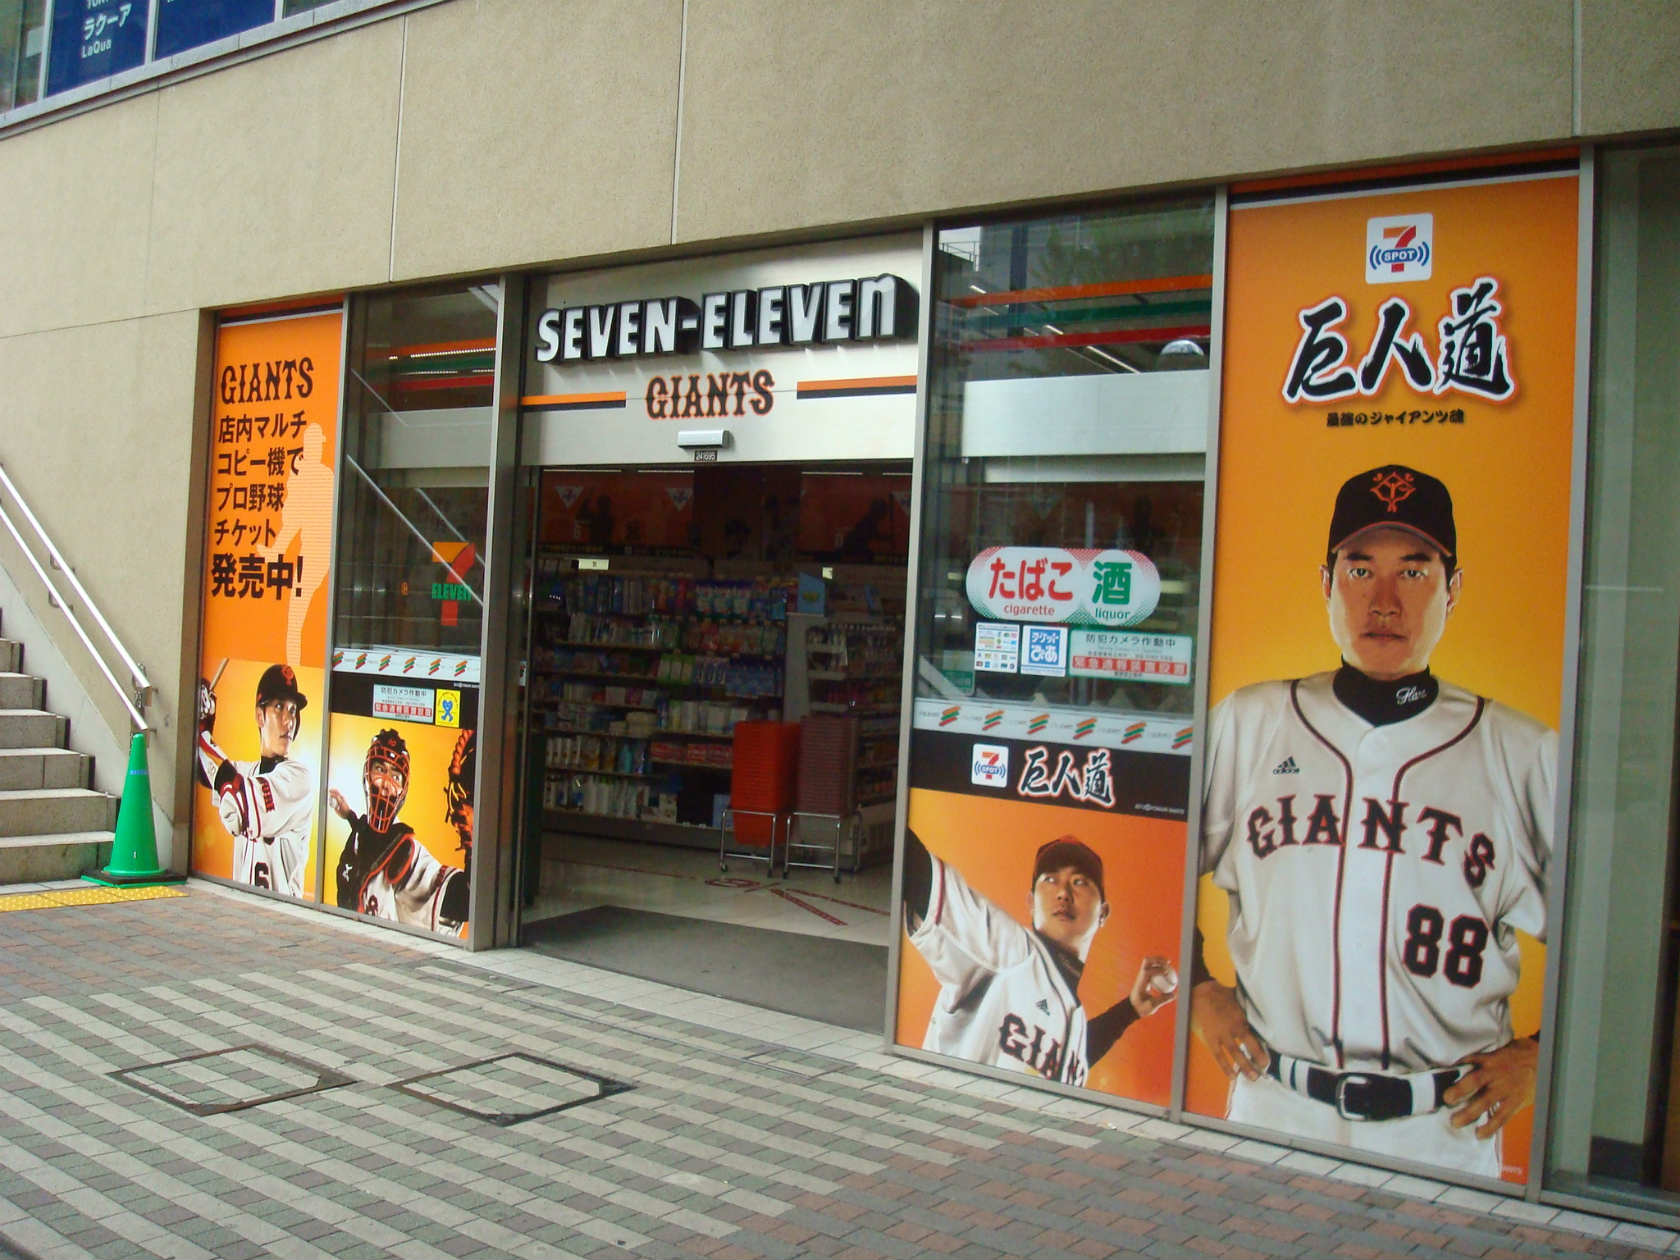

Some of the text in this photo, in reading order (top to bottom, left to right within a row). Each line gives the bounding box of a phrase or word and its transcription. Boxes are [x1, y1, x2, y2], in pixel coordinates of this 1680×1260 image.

[84, 3, 132, 40] ラクーア
[82, 39, 112, 58] LaQua
[1384, 250, 1415, 261] SPOT
[1284, 279, 1513, 399] 巨人道
[221, 357, 315, 405] GIANTS
[646, 369, 775, 420] GIANTS
[218, 410, 308, 443] 店内マルチ
[217, 447, 304, 476] コピー機で
[216, 482, 285, 513] プロ野球
[214, 518, 277, 547] チケット
[988, 557, 1074, 601] たばこ
[1091, 560, 1133, 605] 酒
[1003, 604, 1056, 617] cigarette
[1095, 607, 1131, 620] liquor
[1031, 645, 1058, 663] ぴあ
[1086, 633, 1176, 648] 防犯カメラ作動中
[1019, 747, 1113, 805] 巨人道
[1247, 794, 1496, 888] GIANTS
[1402, 903, 1489, 989] 88
